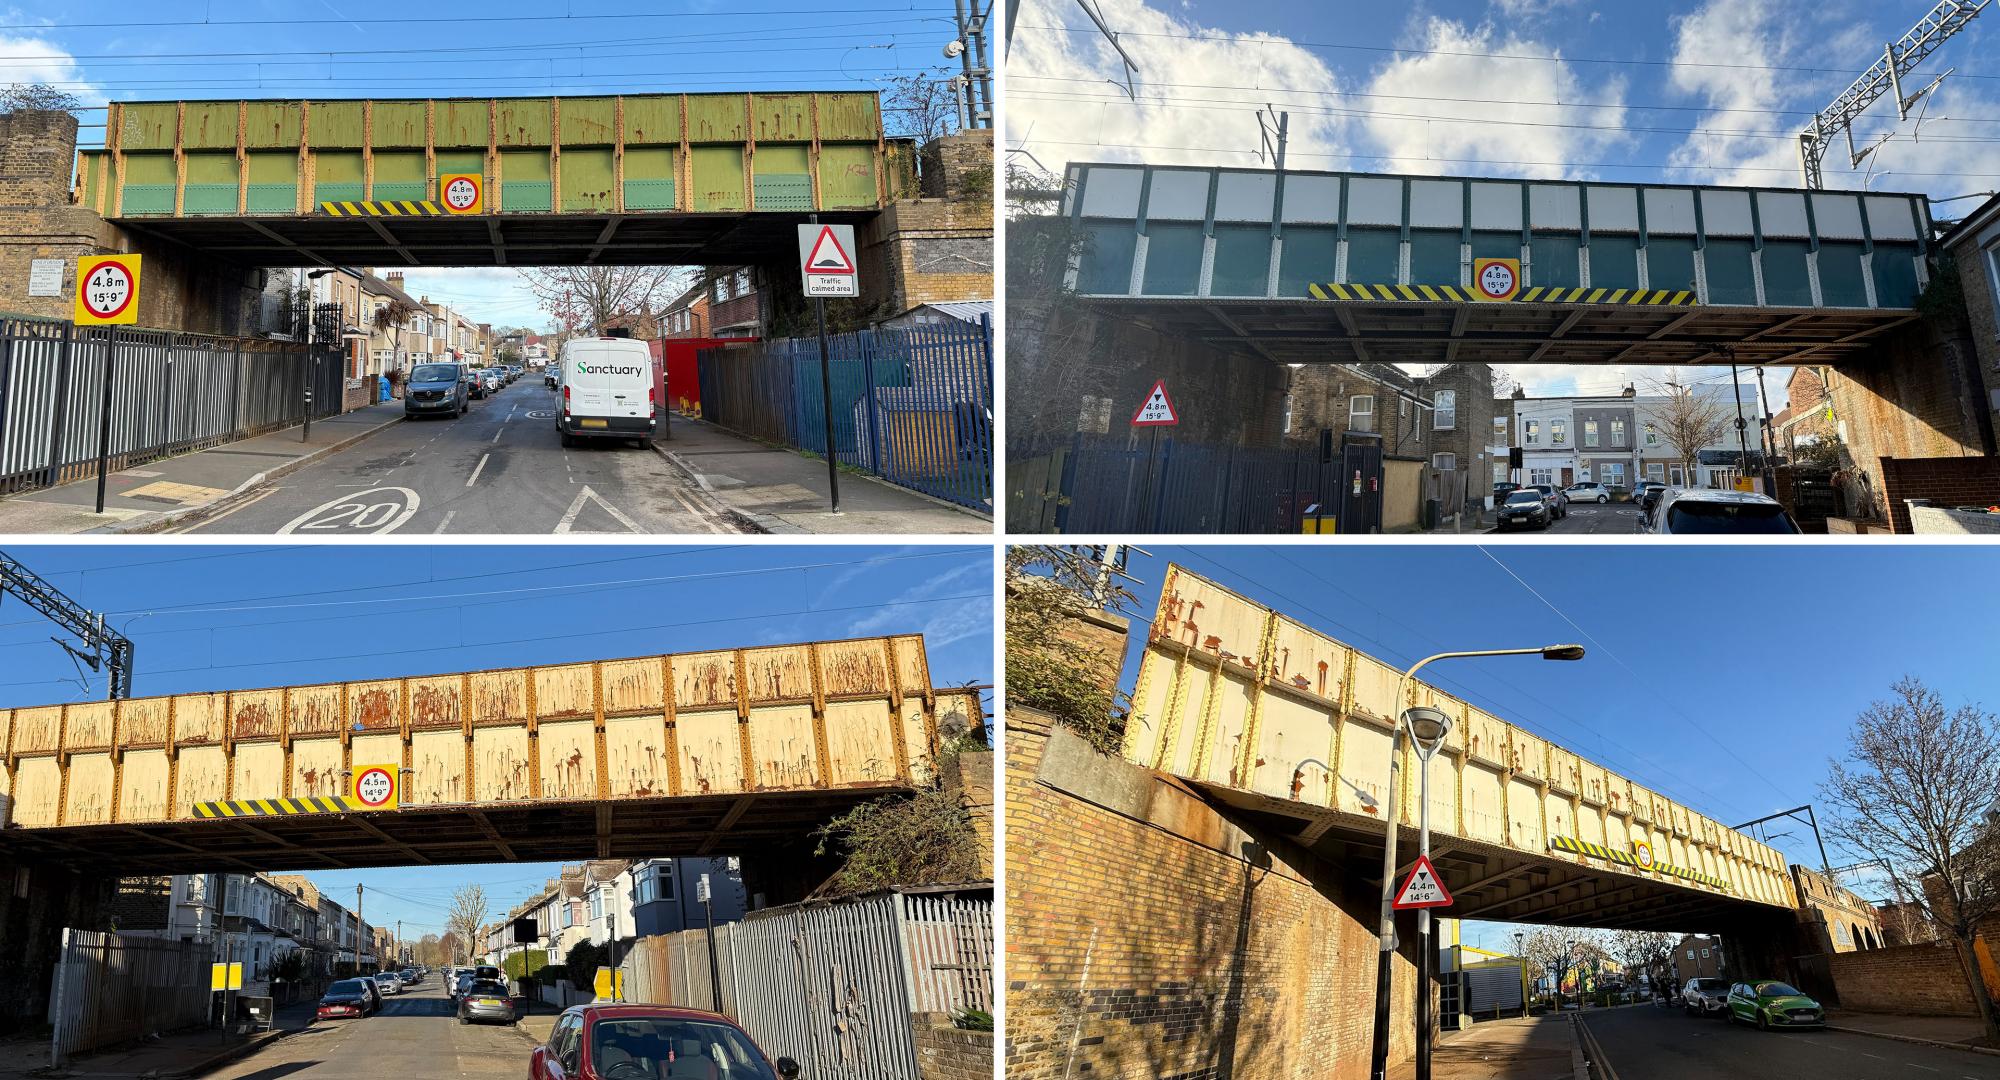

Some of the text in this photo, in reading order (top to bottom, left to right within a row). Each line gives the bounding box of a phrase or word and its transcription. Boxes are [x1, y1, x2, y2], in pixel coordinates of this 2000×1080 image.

[820, 277, 842, 285] Traffic
[577, 361, 642, 378] Sanctuary
[300, 502, 401, 529] 20
